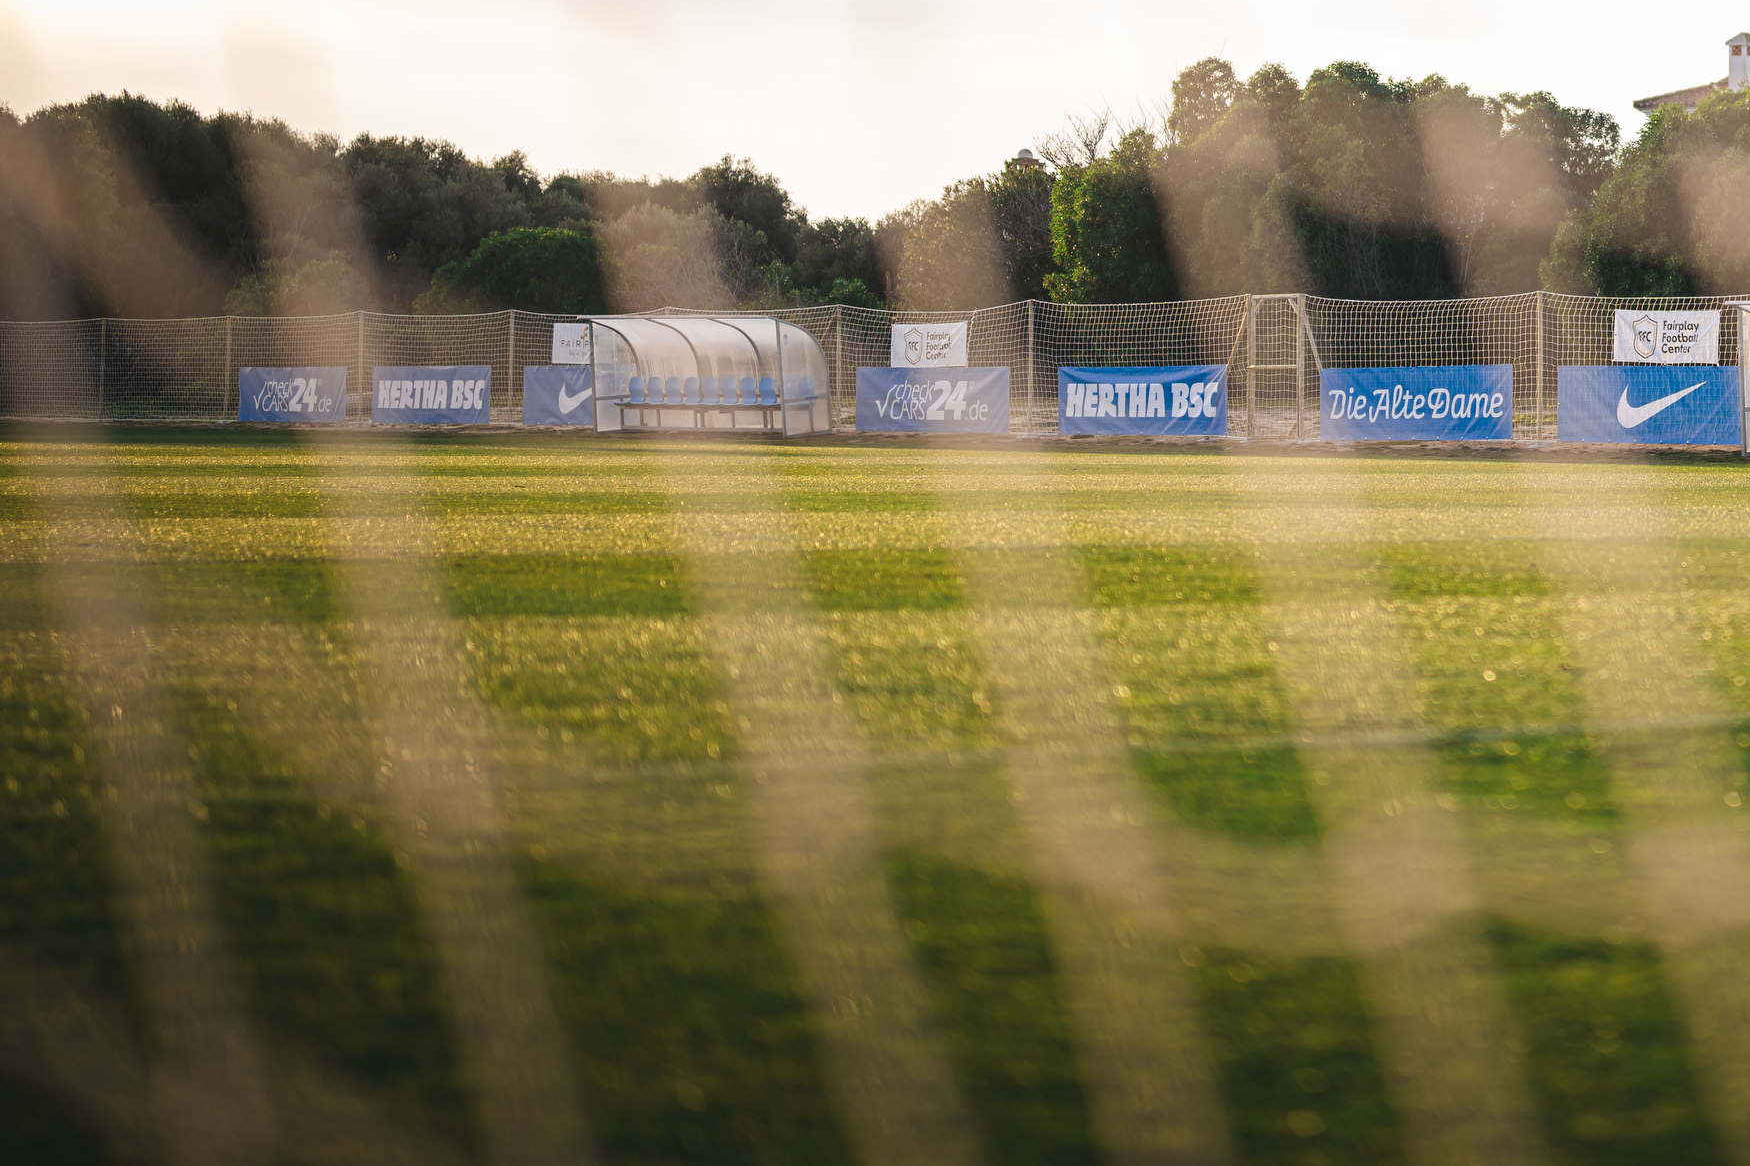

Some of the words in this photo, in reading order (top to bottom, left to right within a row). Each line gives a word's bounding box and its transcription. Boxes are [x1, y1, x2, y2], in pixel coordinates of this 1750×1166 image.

[1662, 320, 1699, 332] Fairplay
[1662, 332, 1699, 343] Football
[1661, 343, 1692, 354] Center
[267, 378, 294, 395] check
[377, 380, 448, 409] HERTHA
[450, 379, 486, 410] BSC
[895, 380, 935, 400] check
[262, 395, 289, 412] CARS
[1065, 382, 1165, 418] HERTHA
[1171, 382, 1219, 418] BSC
[1328, 387, 1367, 420] Die
[1368, 384, 1425, 424] Alte
[1427, 387, 1504, 419] Dame
[889, 400, 927, 420] CARS
